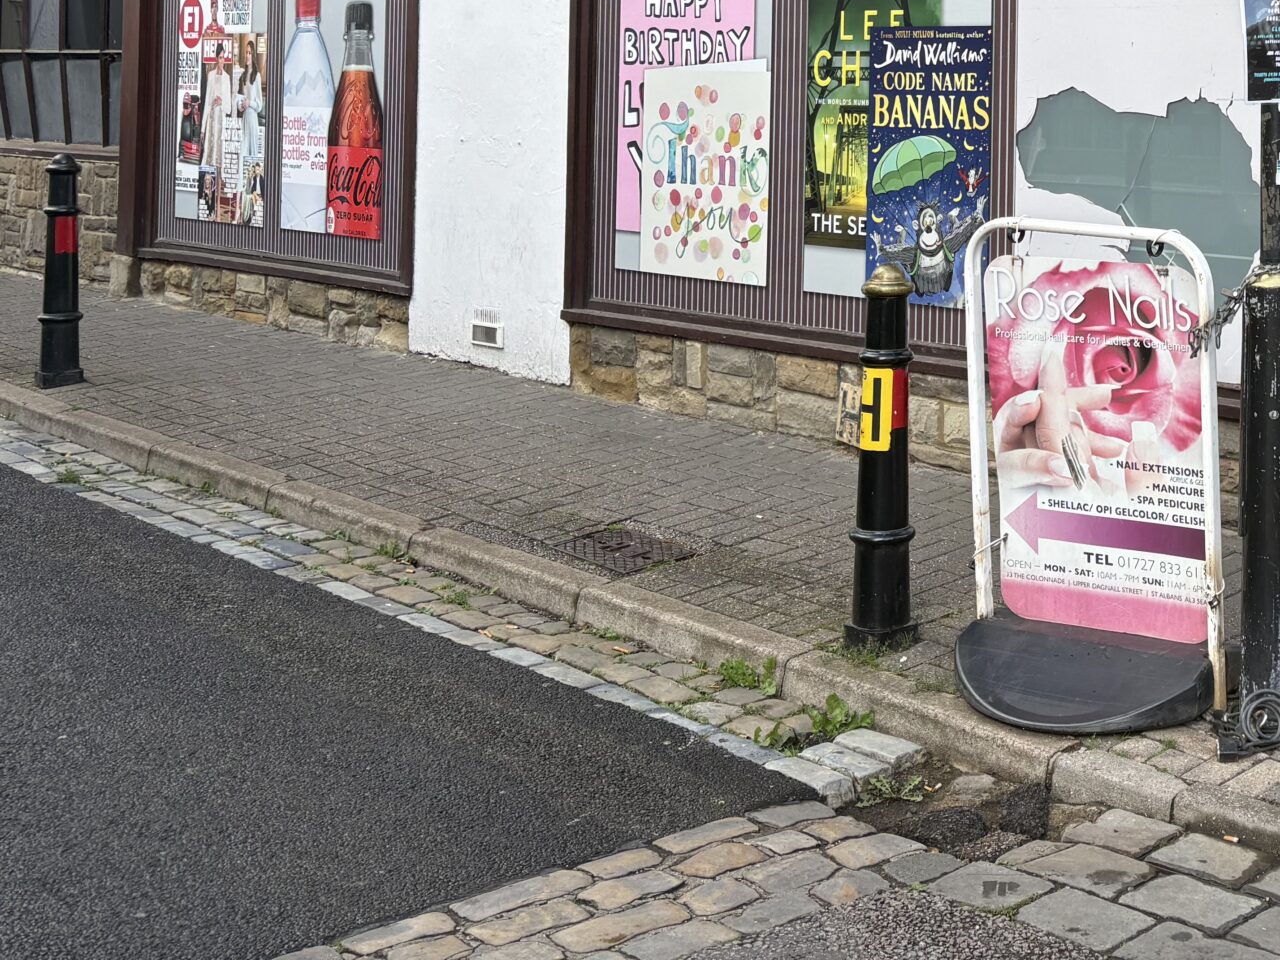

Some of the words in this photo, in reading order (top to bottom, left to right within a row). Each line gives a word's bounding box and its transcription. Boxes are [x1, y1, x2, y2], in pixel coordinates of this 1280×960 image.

[183, 6, 200, 32] F1
[623, 25, 751, 66] BIRTHDAY
[966, 30, 985, 39] author
[874, 39, 923, 69] David
[923, 41, 988, 66] Walliams
[883, 71, 925, 91] CODE
[931, 72, 978, 92] NAME
[282, 115, 307, 131] Bottle
[872, 93, 991, 131] BANANAS
[282, 132, 305, 146] made
[307, 132, 327, 147] from
[282, 146, 310, 161] bottles
[310, 160, 328, 171] evian
[646, 118, 768, 197] Thank
[336, 210, 352, 221] ZERO
[353, 212, 373, 223] SUGAR
[674, 200, 764, 258] you
[811, 212, 843, 235] THE
[989, 267, 1087, 324] Rose
[1107, 274, 1192, 332] Nails
[995, 327, 1047, 342] Professional
[1066, 334, 1085, 344] care
[1087, 333, 1101, 345] for
[1103, 336, 1131, 347] Ladies
[1133, 340, 1141, 348] &
[1143, 339, 1192, 353] Gentlemen
[1116, 460, 1140, 471] NAIL
[1142, 463, 1204, 478] EXTENSIONS
[1152, 483, 1205, 498] MANICURE
[1047, 498, 1094, 513] SHELLAC/
[1096, 505, 1113, 515] OPI
[1114, 507, 1170, 522] GELCOLOR/
[1172, 514, 1206, 527] GELISH
[1137, 495, 1155, 506] SPA
[1158, 498, 1205, 512] PEDICURE
[1006, 558, 1032, 570] OPEN
[1044, 563, 1066, 573] MON
[1074, 567, 1094, 578] SAT:
[1097, 570, 1118, 581] 10AM
[1123, 573, 1140, 584] 7PM
[1142, 576, 1165, 587] SUN:
[1083, 551, 1113, 567] TEL
[1117, 555, 1155, 571] 01727
[1159, 563, 1181, 576] 833
[1014, 572, 1025, 580] THE
[1025, 573, 1066, 585] COLONNADE
[1072, 580, 1091, 589] UPPER
[1121, 586, 1143, 596] STREET
[1159, 591, 1183, 602] ALBANS
